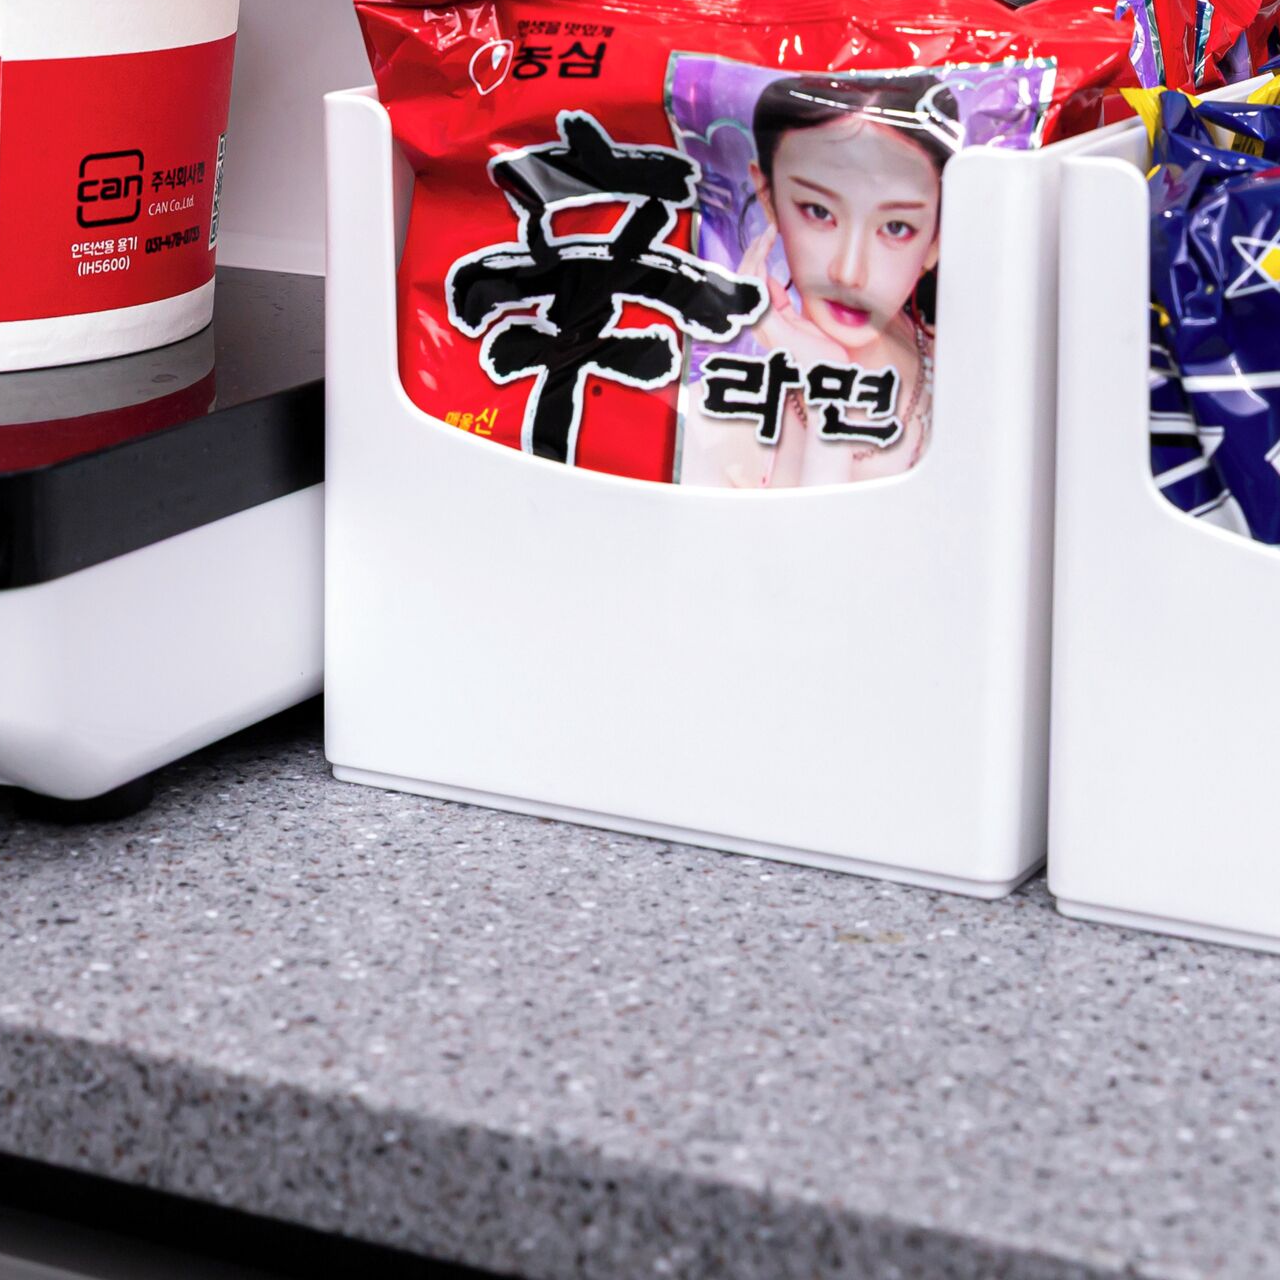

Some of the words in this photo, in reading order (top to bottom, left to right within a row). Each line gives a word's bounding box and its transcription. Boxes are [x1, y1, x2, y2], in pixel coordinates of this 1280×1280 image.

[512, 41, 607, 80] 농심
[77, 174, 143, 203] can
[148, 201, 169, 217] CAN
[71, 239, 115, 259] 인덕션용
[117, 236, 138, 252] 용기
[77, 255, 131, 277] (IH5600)
[702, 350, 900, 443] 라면
